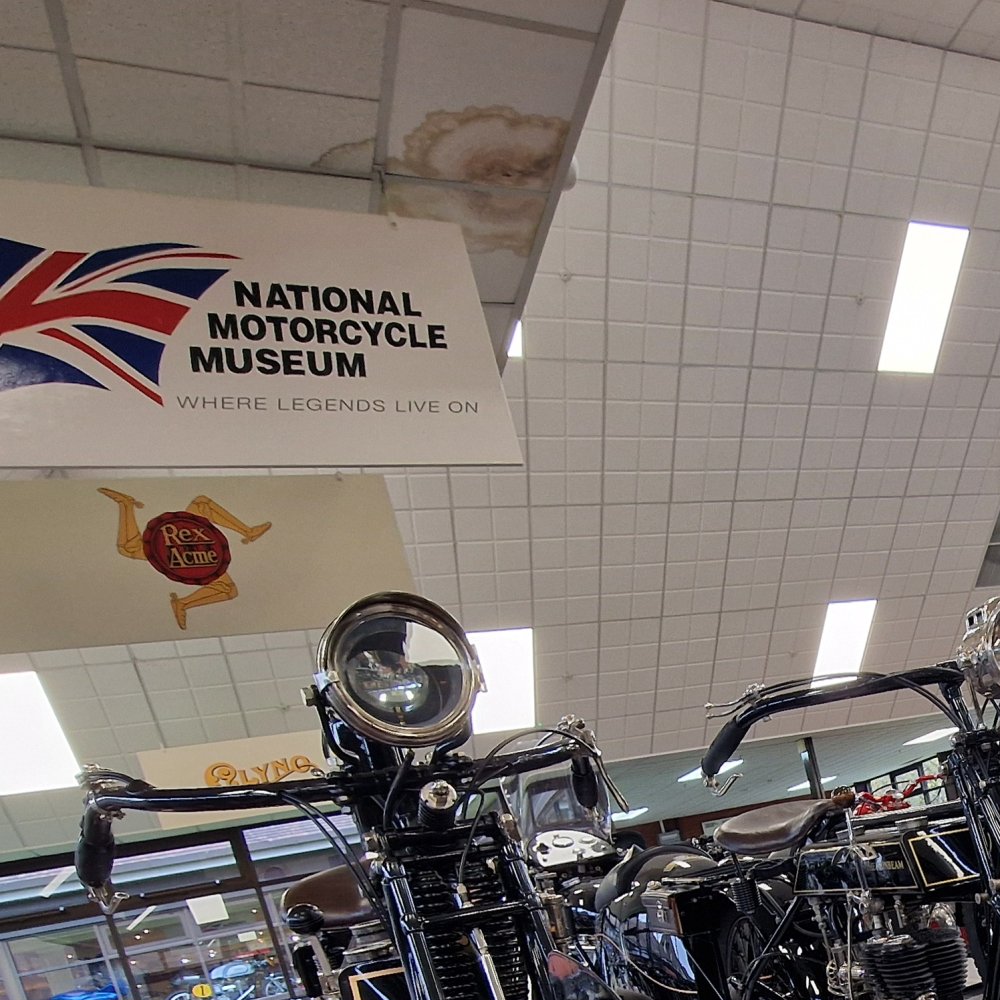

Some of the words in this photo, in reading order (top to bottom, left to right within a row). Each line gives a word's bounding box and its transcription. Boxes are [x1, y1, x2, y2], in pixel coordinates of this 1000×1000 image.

[234, 281, 422, 317] NATIONAL
[208, 312, 448, 349] MOTORCYCLE
[189, 346, 367, 377] MUSEUM
[177, 396, 268, 410] WHERE
[278, 398, 386, 413] LEGENDS
[395, 400, 440, 413] LIVE
[448, 401, 479, 414] ON
[160, 523, 213, 546] Rex
[169, 547, 219, 568] Acme
